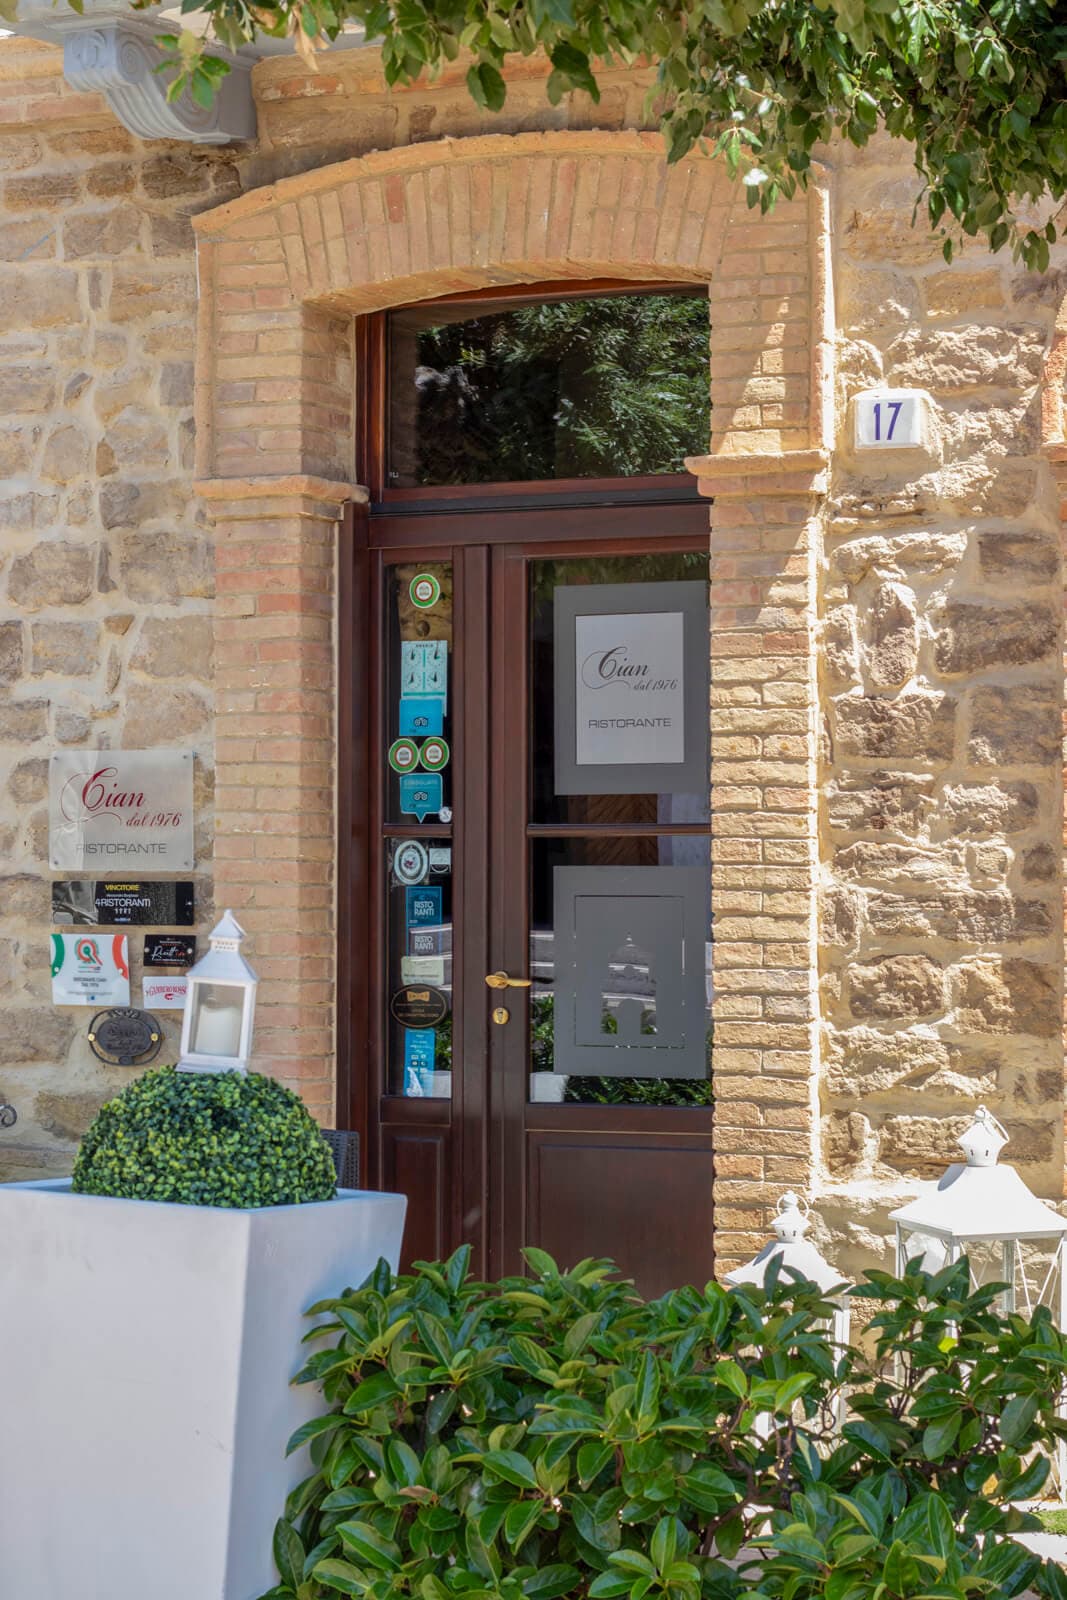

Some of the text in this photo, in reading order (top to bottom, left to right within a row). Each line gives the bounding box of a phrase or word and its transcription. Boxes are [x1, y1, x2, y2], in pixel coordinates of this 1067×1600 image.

[873, 402, 903, 441] 17
[582, 646, 649, 690] Cian
[633, 679, 678, 691] dal 1976
[588, 717, 672, 729] RISTORANTE
[60, 767, 146, 823] Cian
[126, 812, 183, 828] dal 1976
[76, 842, 168, 854] RISTORANTE
